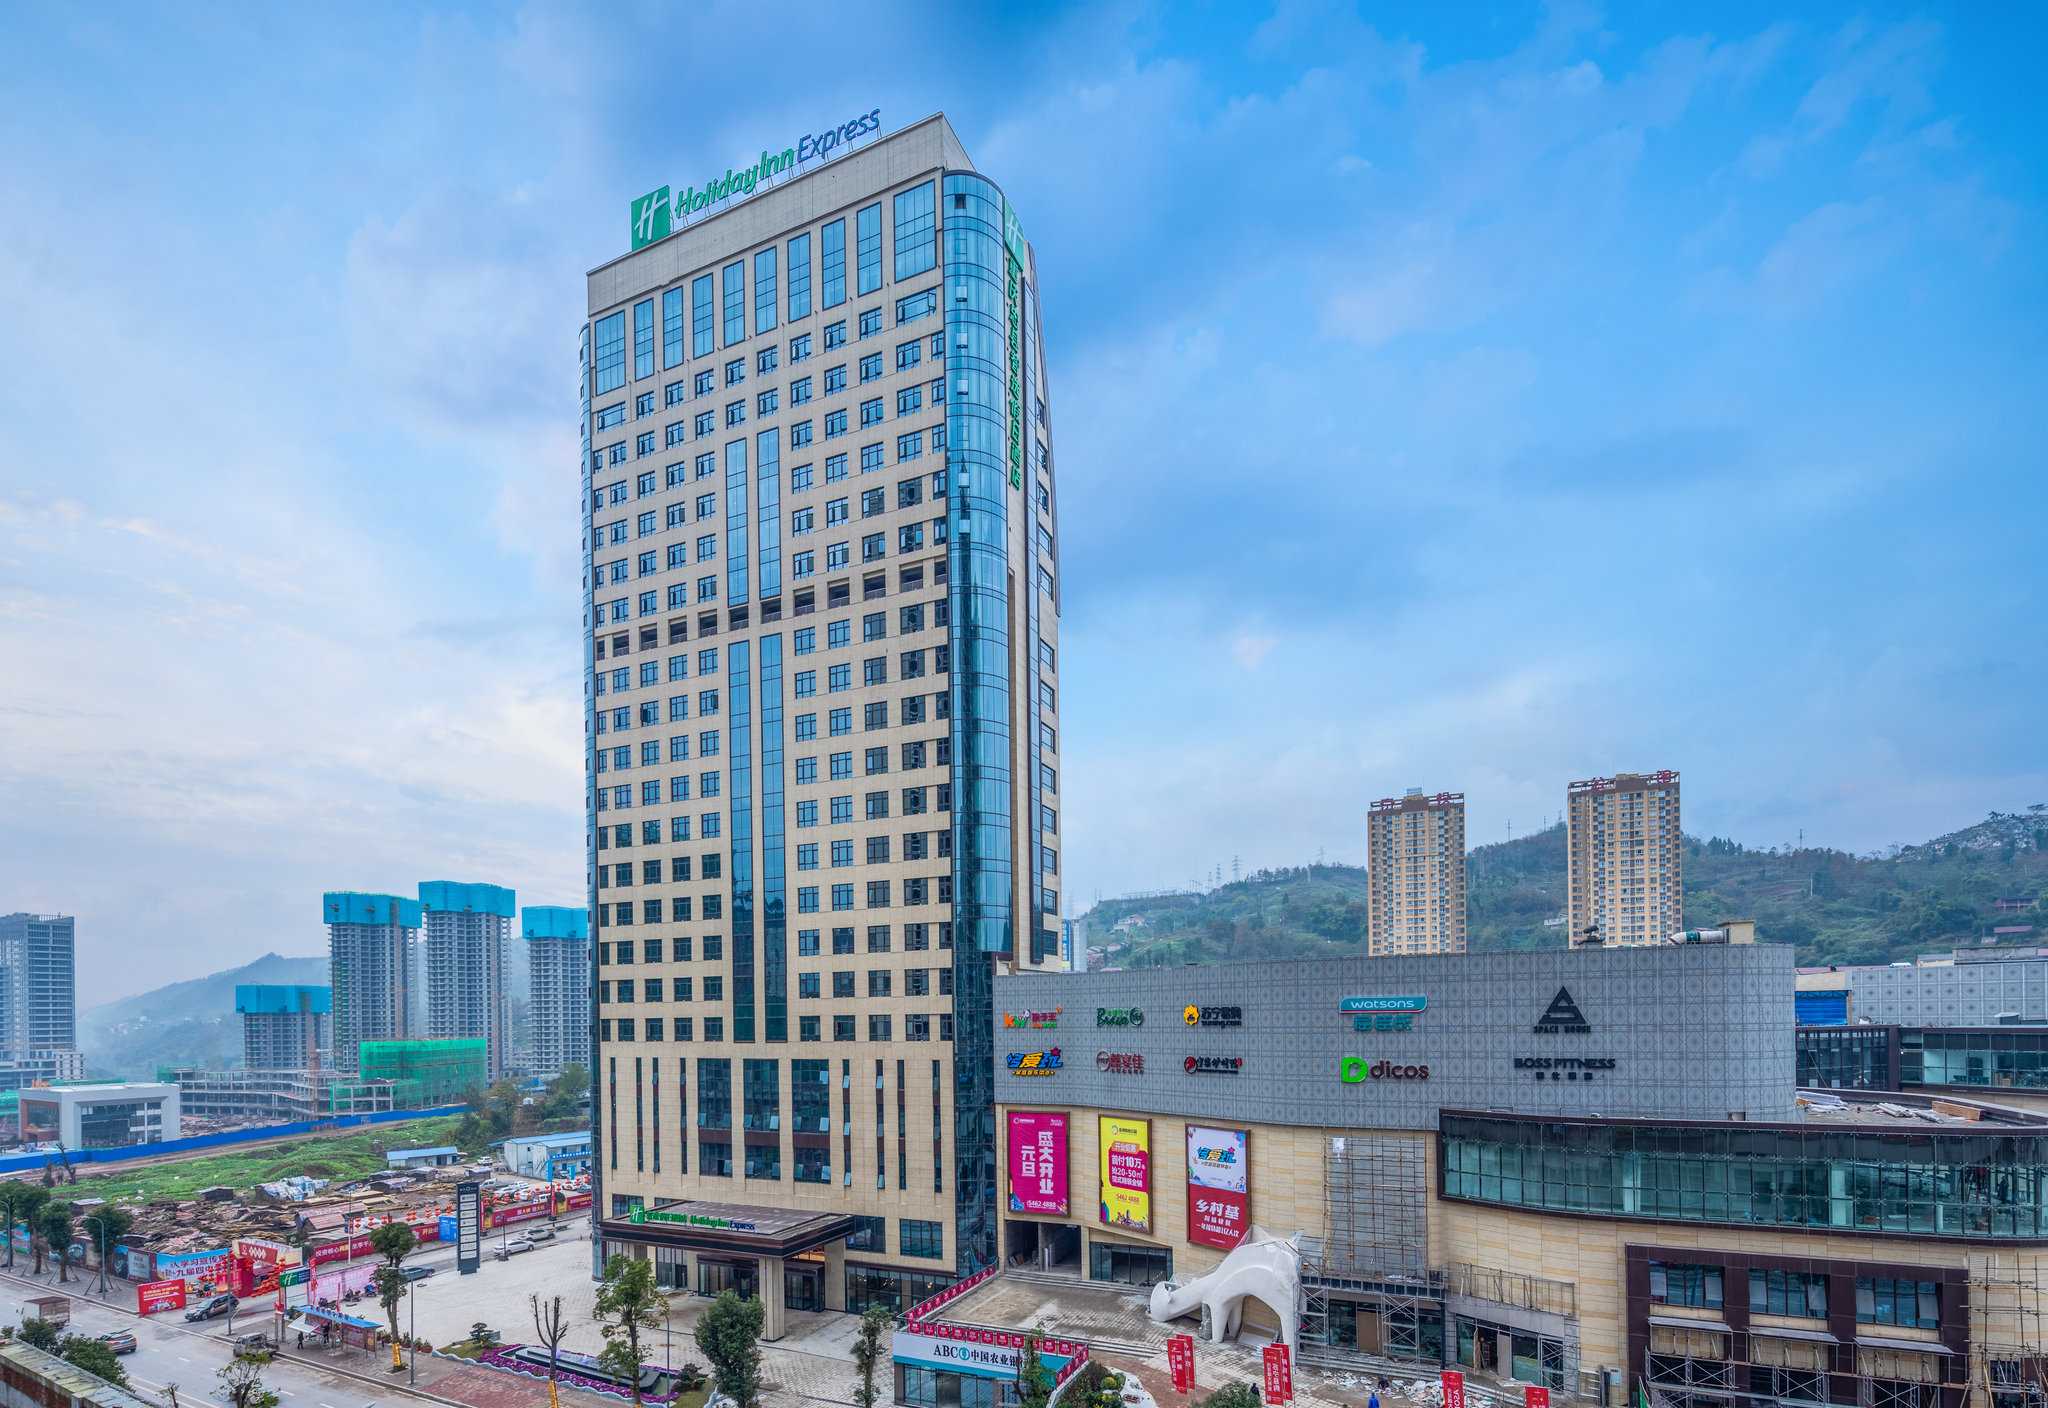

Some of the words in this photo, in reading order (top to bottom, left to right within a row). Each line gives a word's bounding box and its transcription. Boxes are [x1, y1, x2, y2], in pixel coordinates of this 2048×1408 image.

[674, 163, 759, 220] Holiday
[758, 148, 795, 181] Inn
[796, 107, 881, 164] Express
[1350, 1000, 1415, 1009] watsons
[1533, 1025, 1559, 1034] SPACE
[1370, 1060, 1429, 1080] dicos
[1514, 1057, 1552, 1069] BOSS
[1554, 1058, 1615, 1069] FITNESS
[1021, 1144, 1036, 1177] 元旦
[1038, 1131, 1054, 1195] 盛大开业
[1195, 1199, 1240, 1220] 乡村基
[933, 1344, 958, 1359] ABC
